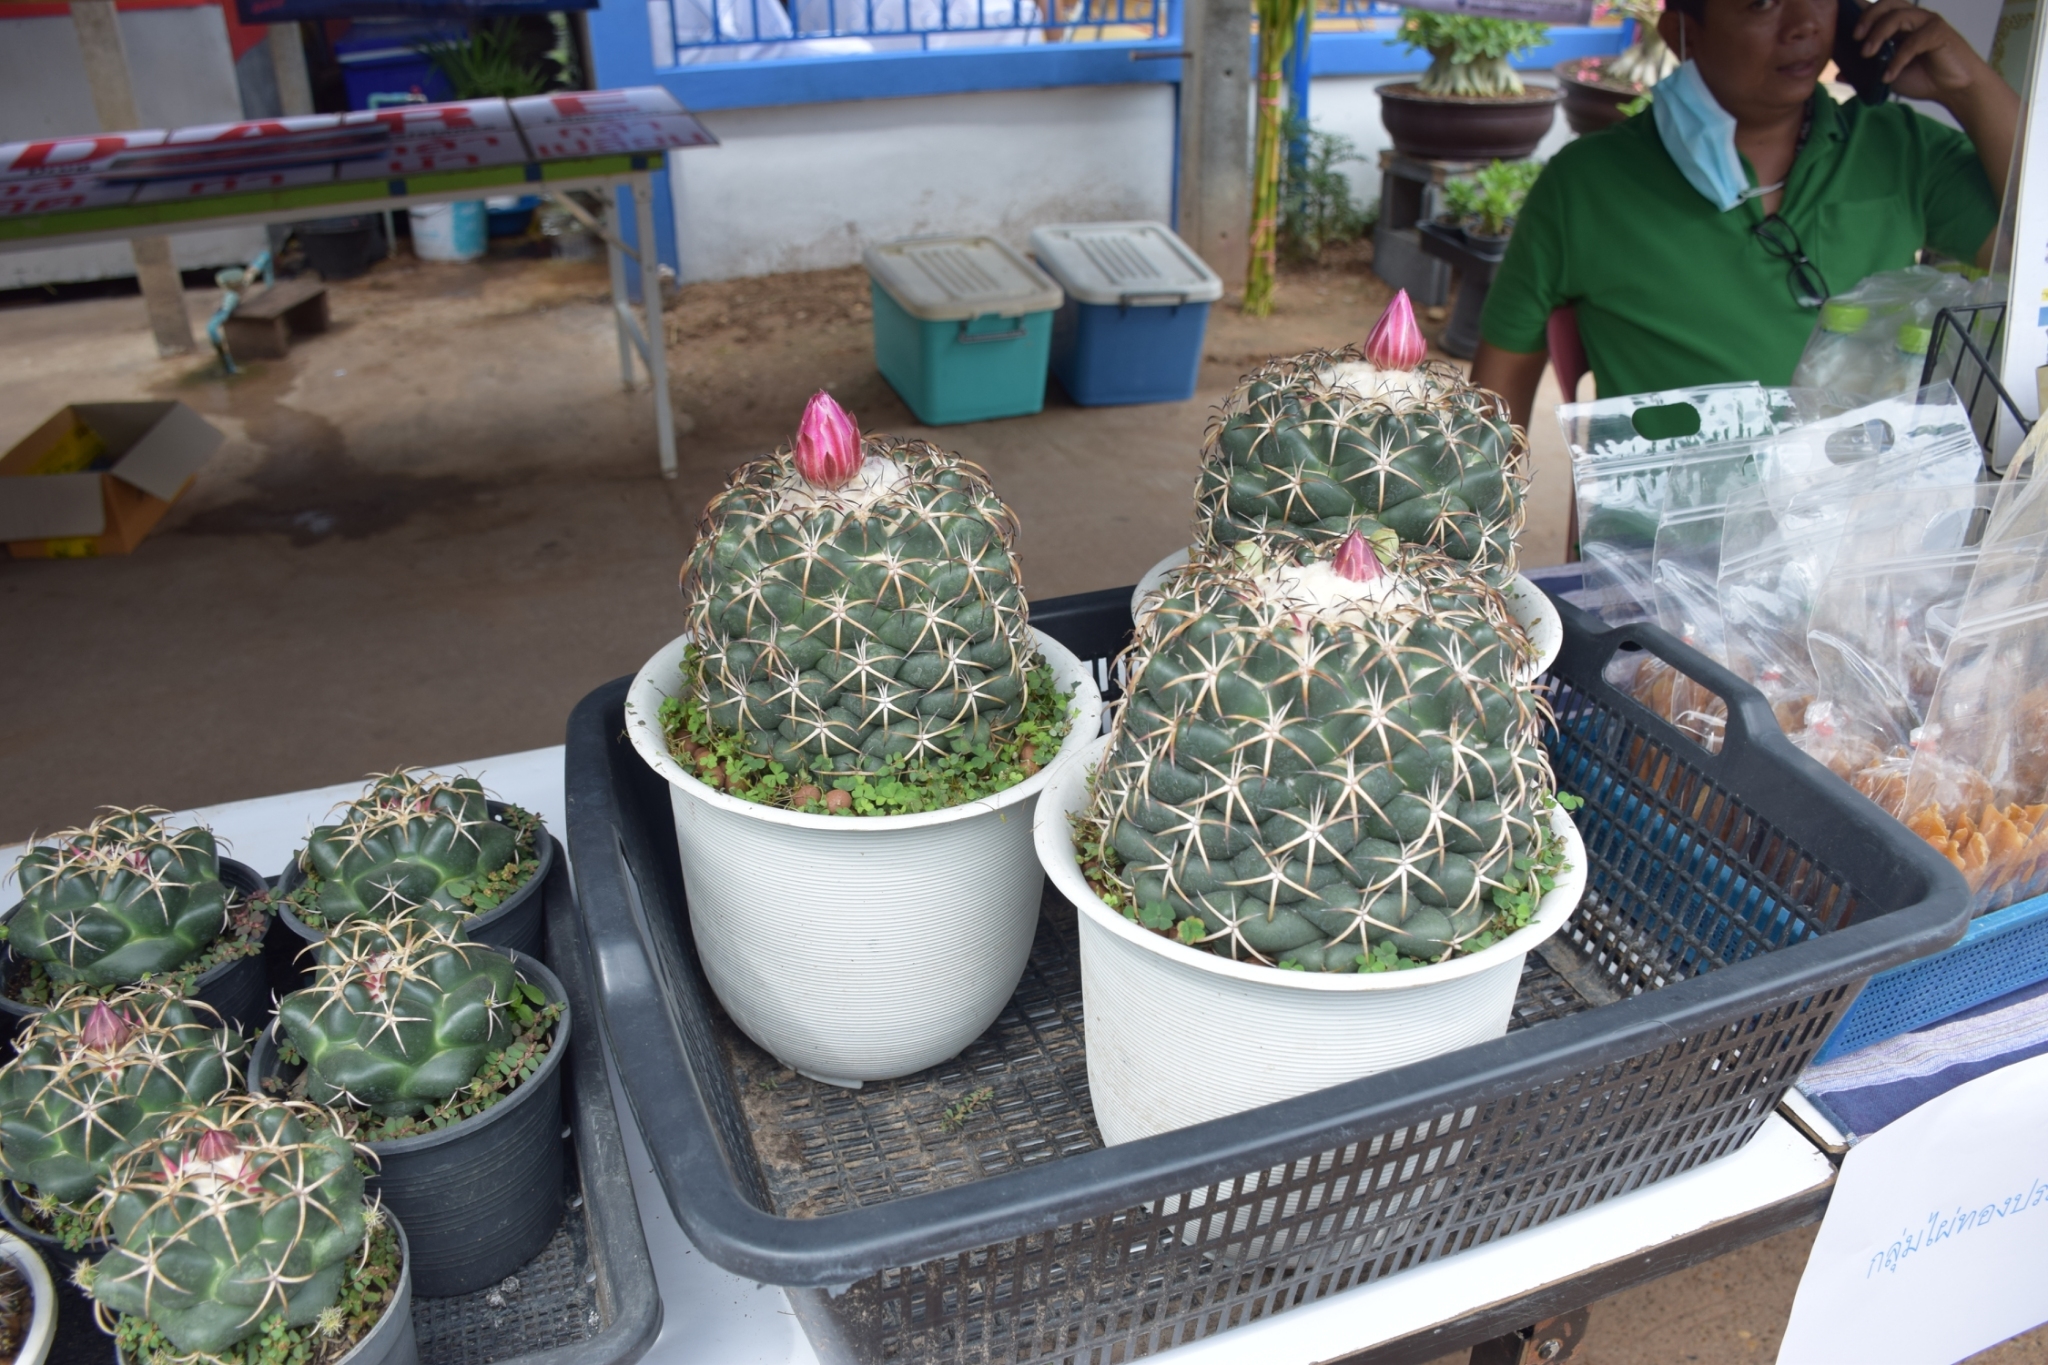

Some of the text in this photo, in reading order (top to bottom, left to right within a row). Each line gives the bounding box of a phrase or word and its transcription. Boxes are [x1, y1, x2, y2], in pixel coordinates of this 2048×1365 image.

[1867, 1178, 2048, 1279] กลุ่มไผ่ทองปร
